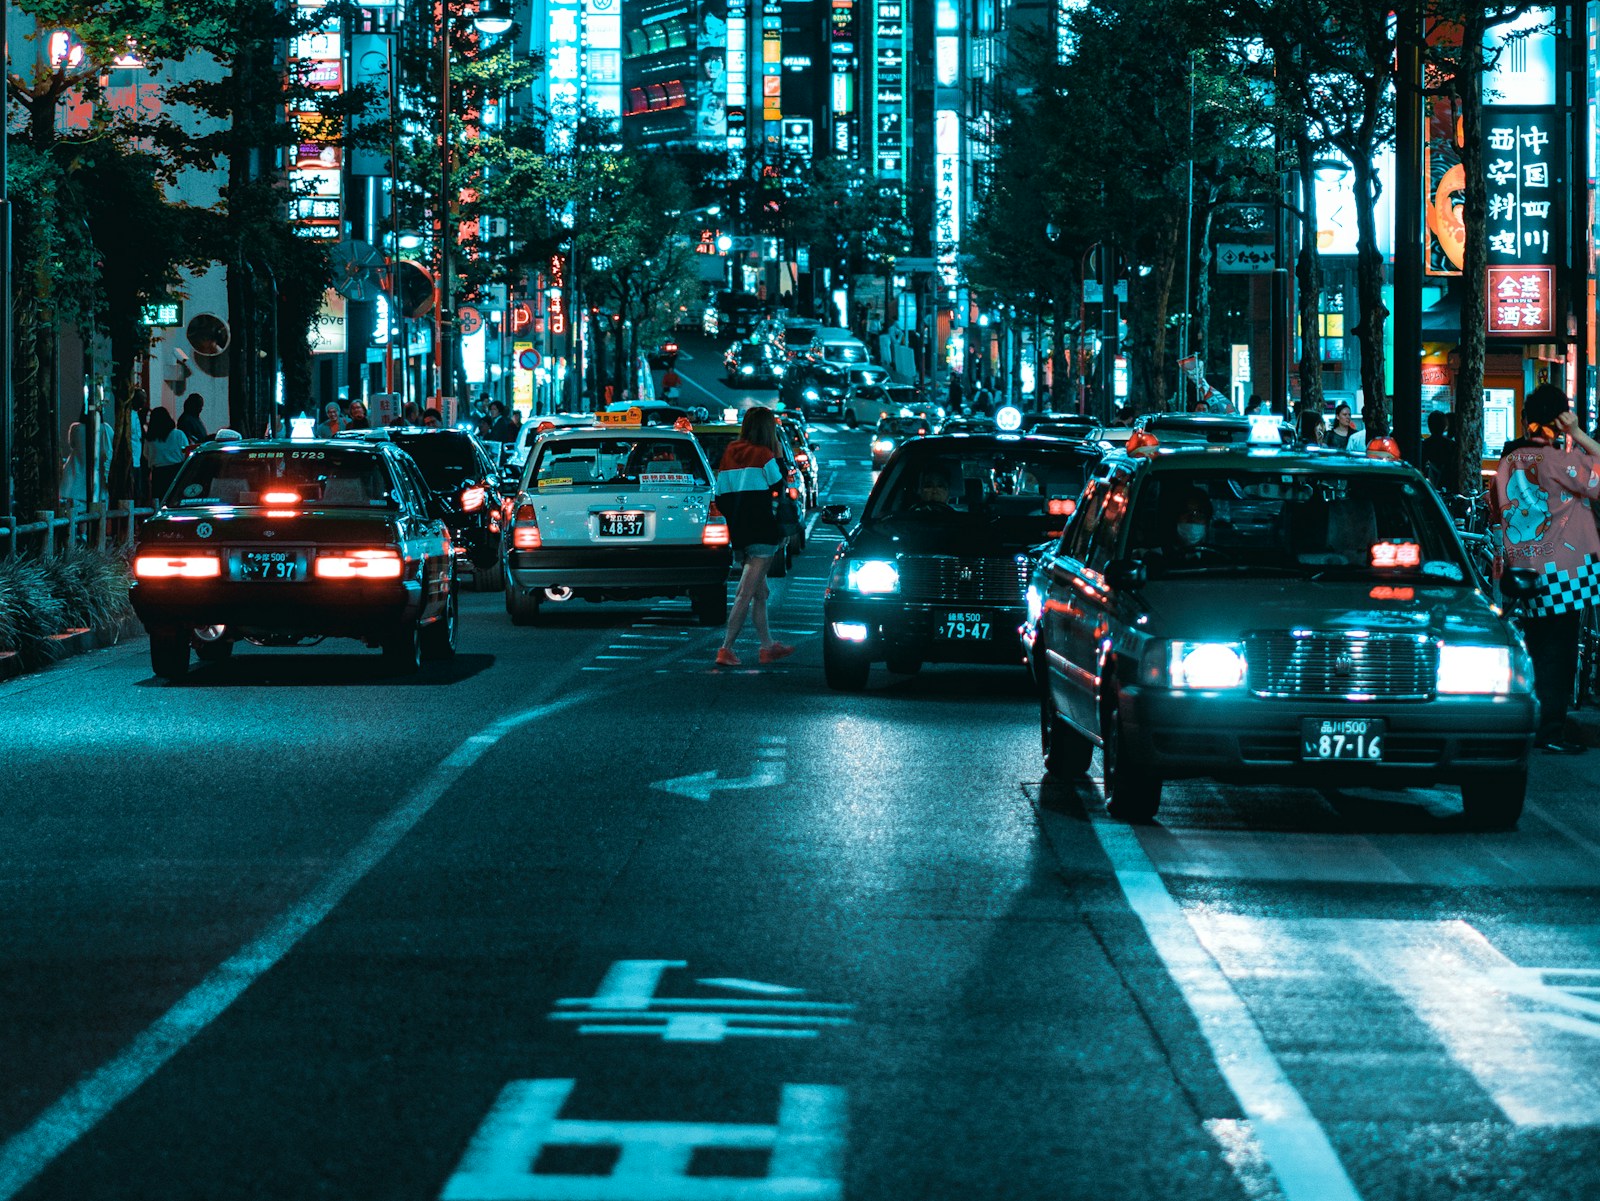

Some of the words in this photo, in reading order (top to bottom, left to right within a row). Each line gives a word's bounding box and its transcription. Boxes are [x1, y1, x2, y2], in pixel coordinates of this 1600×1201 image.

[1487, 128, 1517, 256] 西安料理
[1521, 125, 1551, 255] 中国四川
[609, 523, 643, 535] 48-37
[271, 553, 286, 562] 500
[966, 613, 981, 622] 500
[946, 623, 990, 639] 79-47
[1320, 721, 1345, 733] 品川
[1345, 721, 1367, 733] 500
[1318, 735, 1381, 757] 87-16
